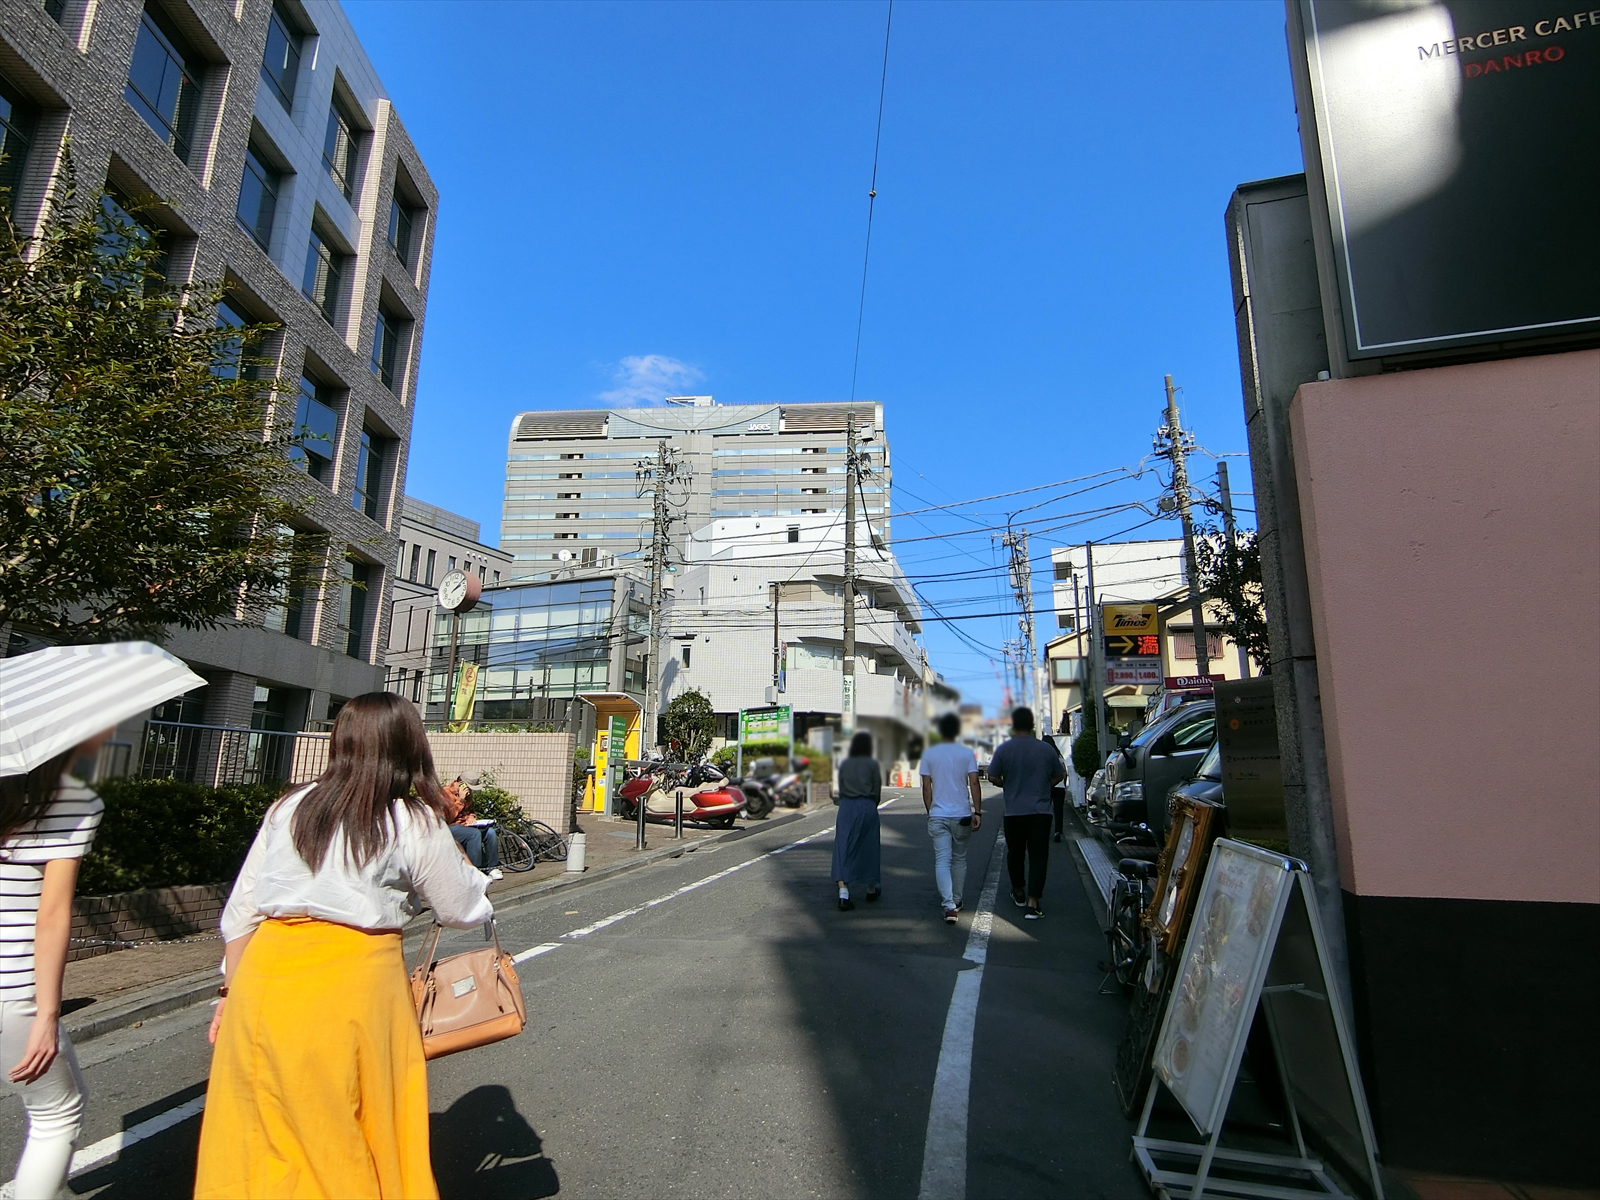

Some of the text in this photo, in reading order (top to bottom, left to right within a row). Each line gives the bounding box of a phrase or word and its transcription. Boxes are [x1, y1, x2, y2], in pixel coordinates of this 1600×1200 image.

[1418, 9, 1600, 61] MERCER CAFE
[1464, 45, 1566, 79] DANRO
[747, 423, 771, 432] JACCS
[1113, 614, 1152, 628] Times
[1137, 635, 1159, 655] 満
